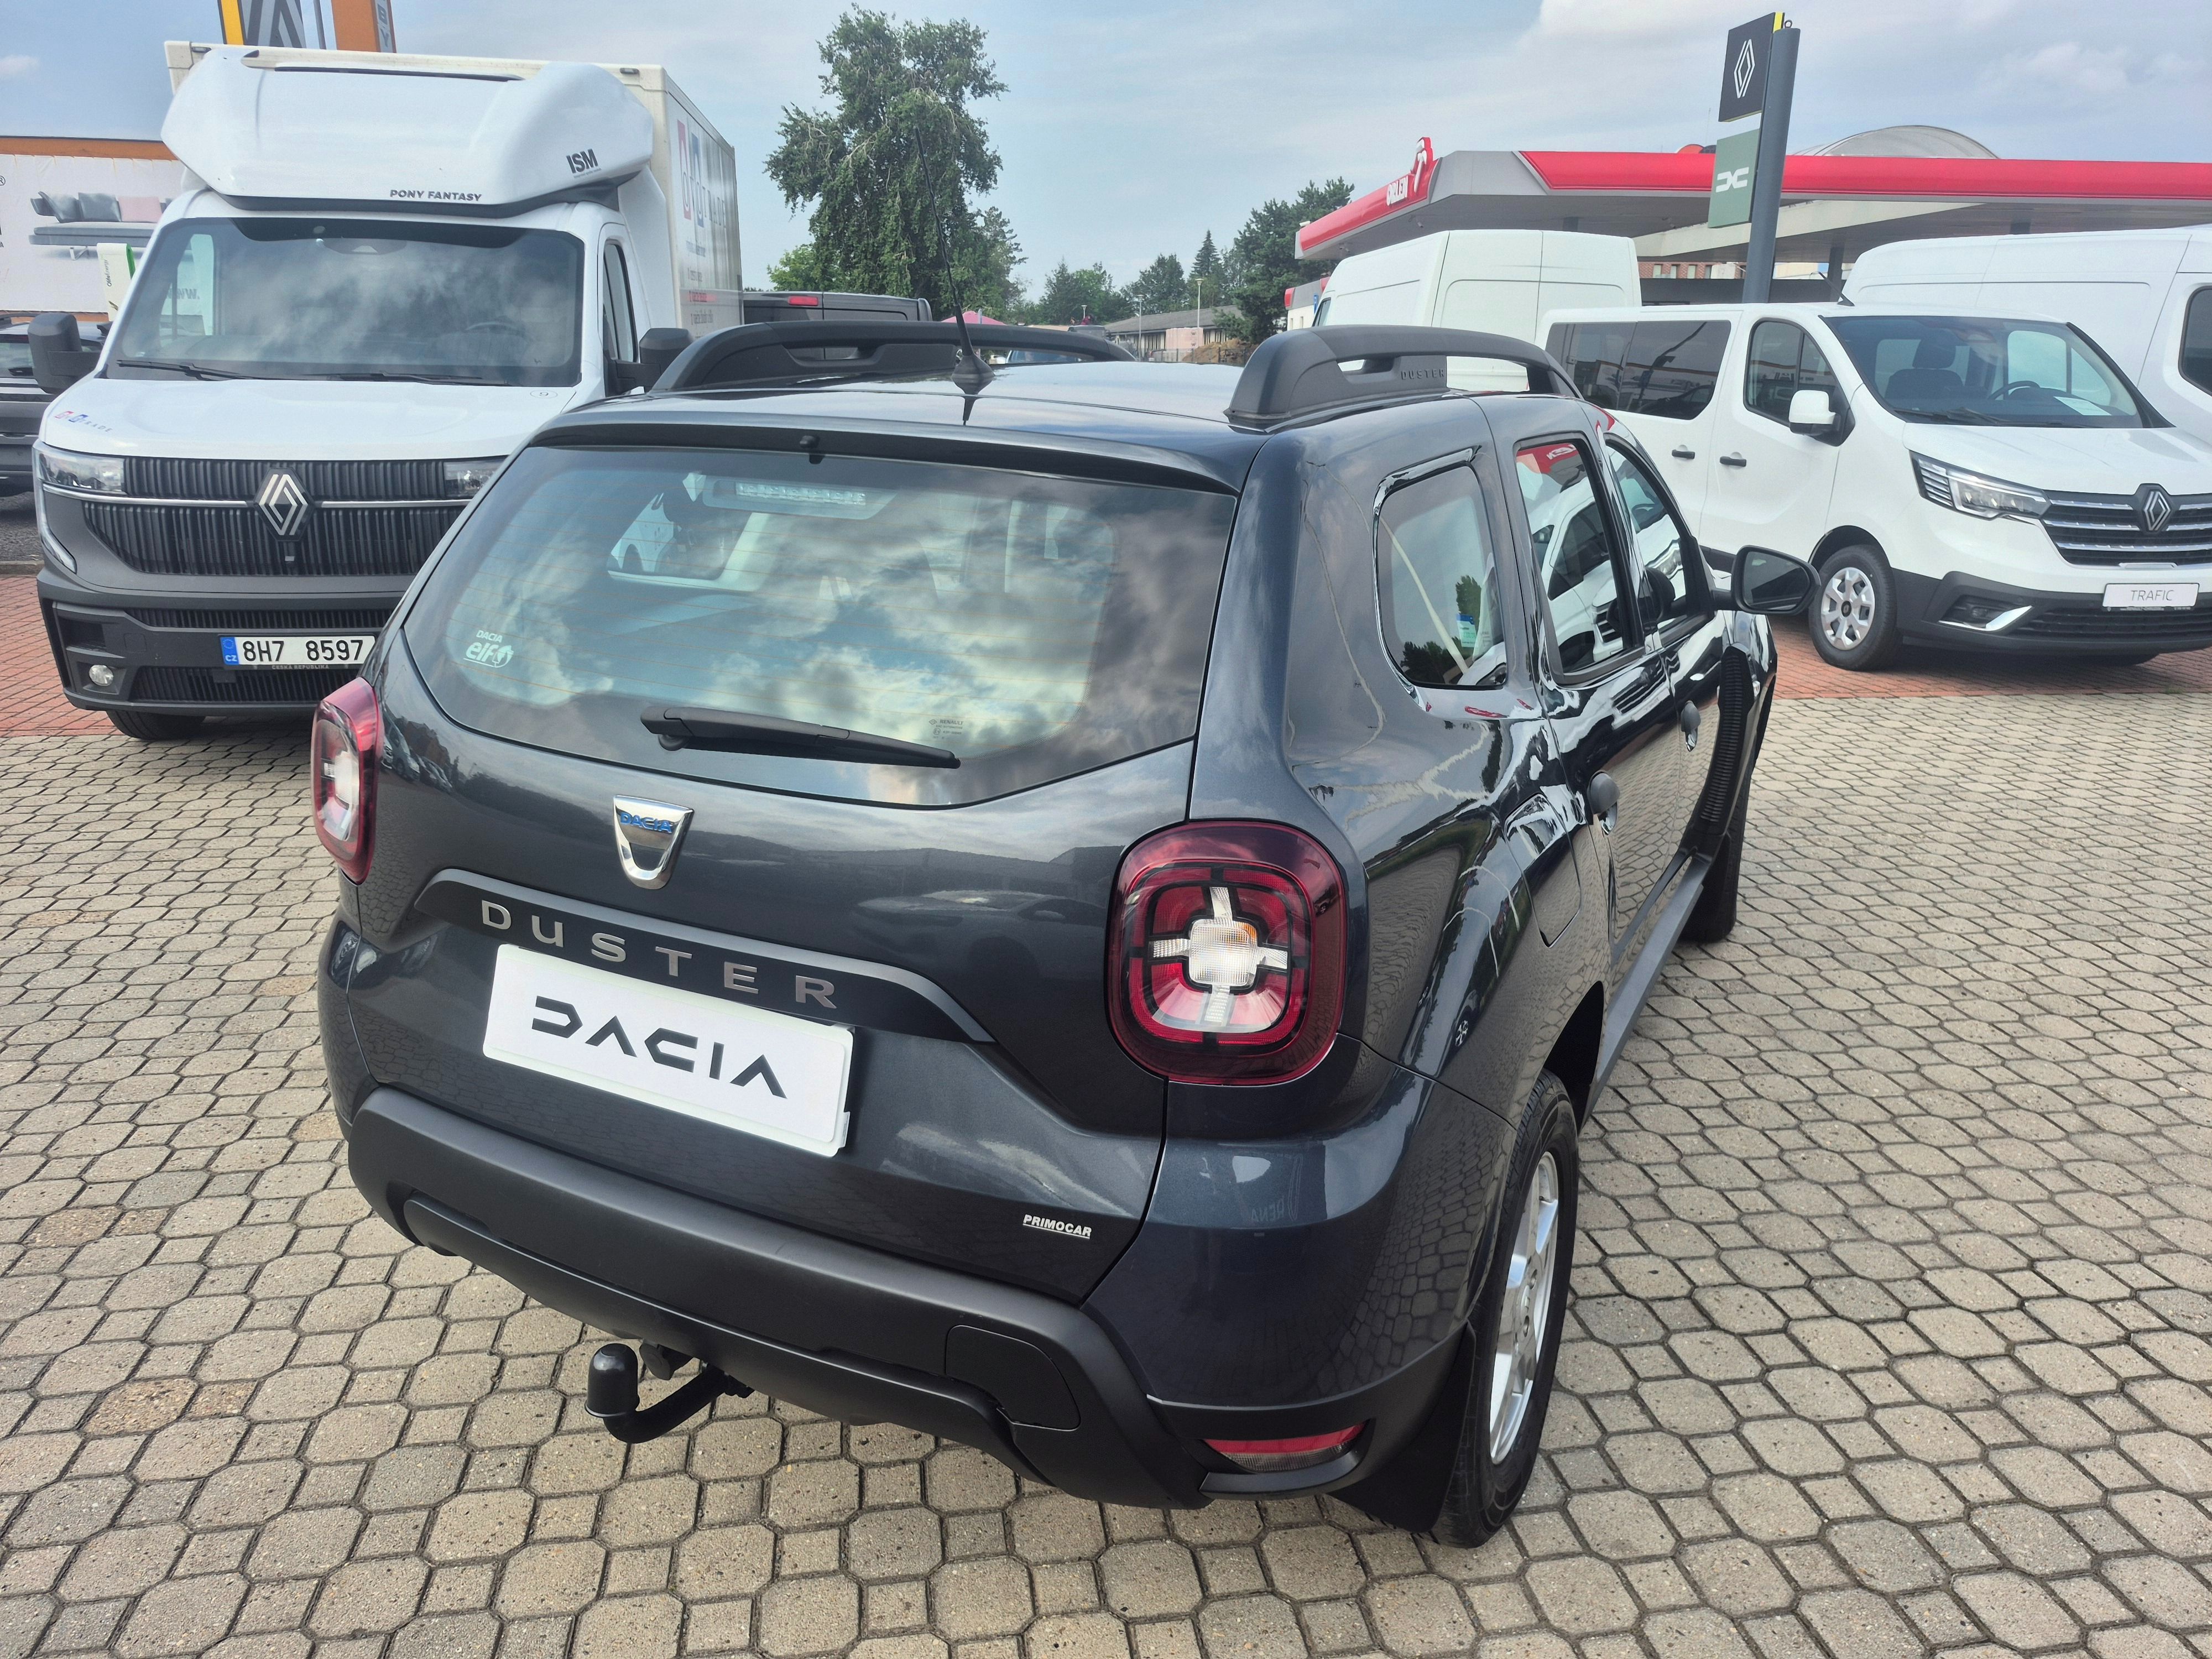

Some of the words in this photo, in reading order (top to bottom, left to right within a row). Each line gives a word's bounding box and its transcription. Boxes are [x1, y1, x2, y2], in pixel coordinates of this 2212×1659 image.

[566, 148, 598, 174] ISM
[390, 189, 425, 198] PONY
[427, 191, 482, 201] FANTASY
[1386, 175, 1408, 206] ORLEN
[1401, 369, 1445, 380] DUSTER
[2131, 590, 2174, 601] TRAFIC
[476, 630, 503, 643] DACIA
[242, 640, 284, 662] 8H7
[305, 639, 363, 661] 8597
[466, 642, 499, 662] elf
[620, 811, 672, 833] DACIA
[482, 900, 837, 1009] DUSTER
[531, 996, 787, 1099] DACIA
[1022, 1214, 1092, 1238] PRIMOCAR
